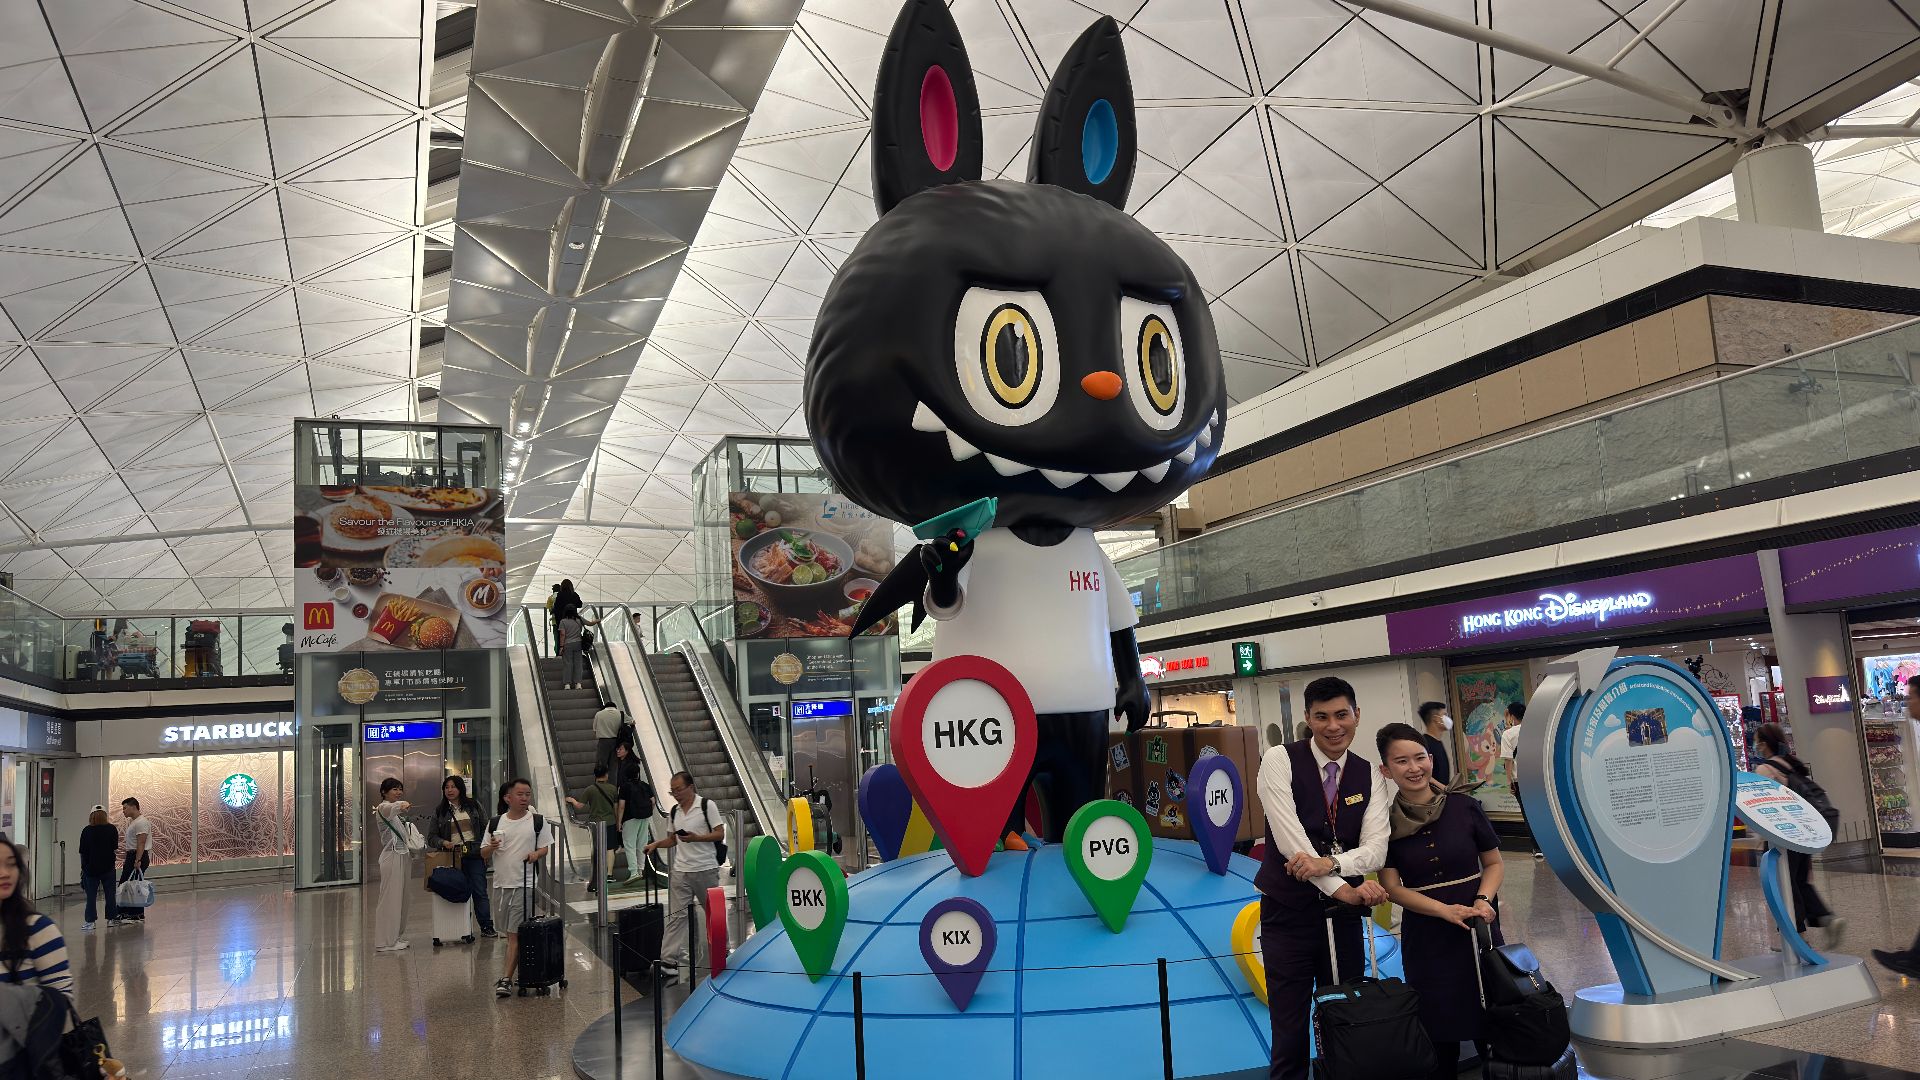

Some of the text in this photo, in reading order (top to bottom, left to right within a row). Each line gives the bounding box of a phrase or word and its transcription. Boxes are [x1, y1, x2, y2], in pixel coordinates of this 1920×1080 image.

[339, 517, 475, 527] Savour the Flavours of HKIA
[1069, 570, 1100, 591] HKG
[1463, 612, 1501, 633] HONG
[1504, 606, 1542, 627] KONG
[301, 634, 337, 648] McCafé
[164, 721, 294, 742] STARBUCK
[934, 717, 1003, 748] HKG
[1208, 789, 1229, 807] JFK
[1089, 837, 1130, 858] PVG
[791, 889, 825, 907] BKK
[942, 930, 971, 946] KIX
